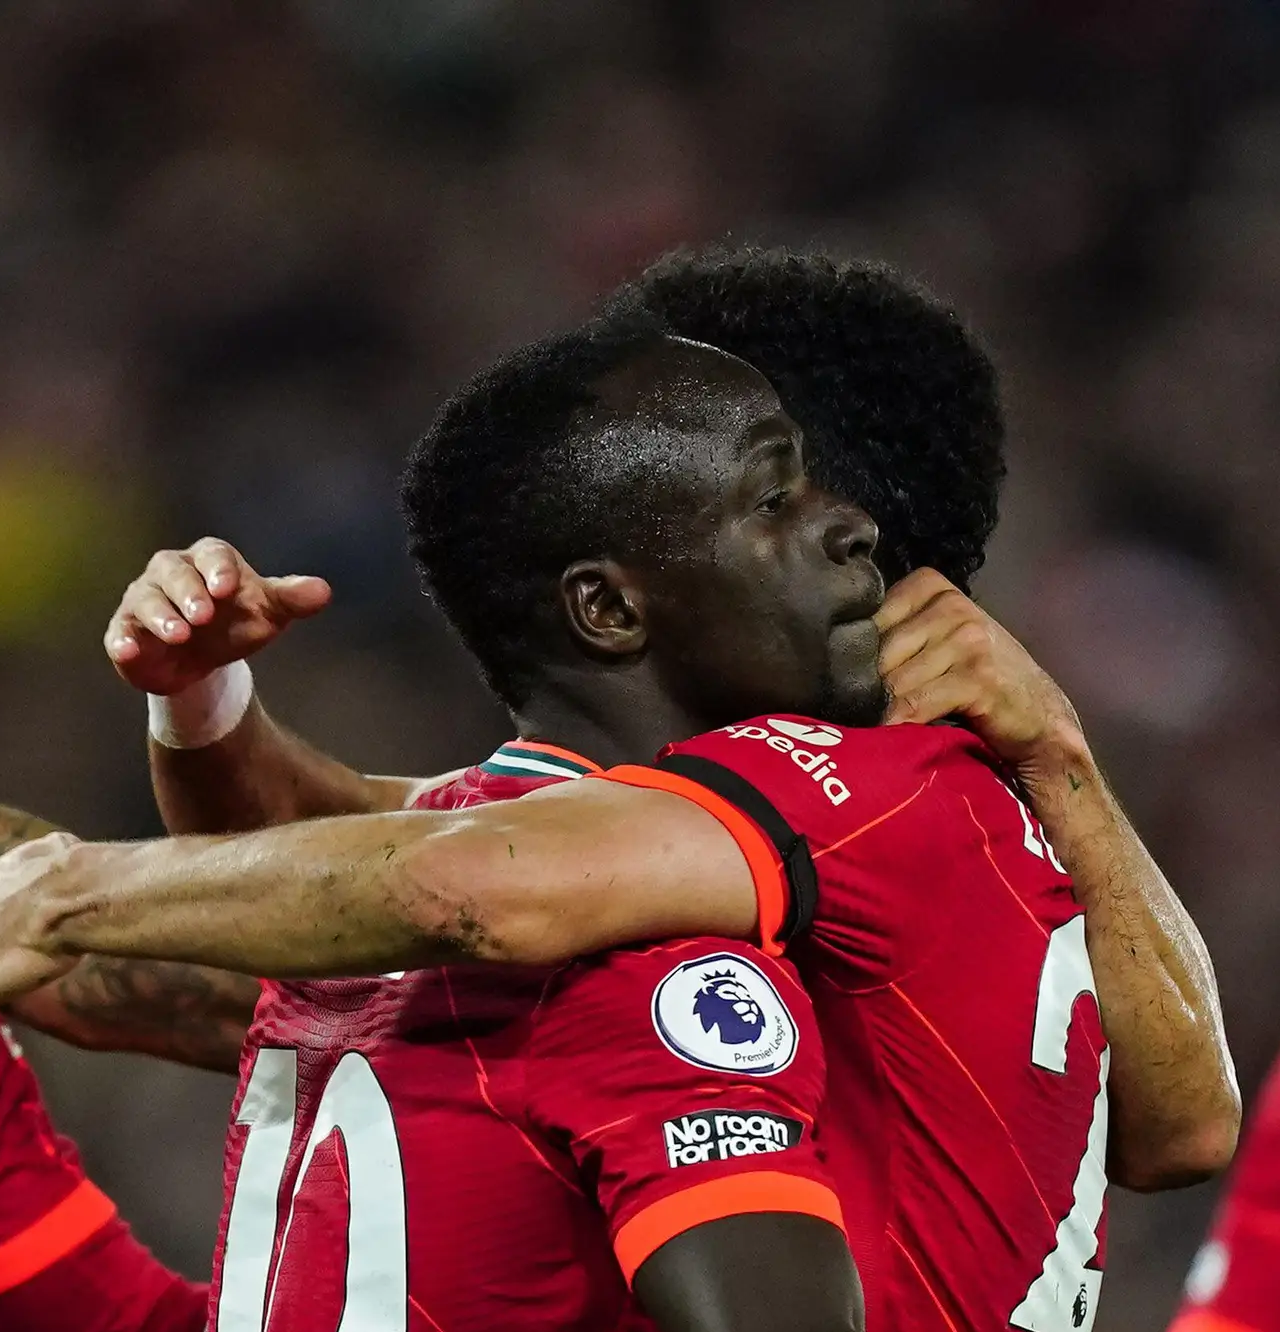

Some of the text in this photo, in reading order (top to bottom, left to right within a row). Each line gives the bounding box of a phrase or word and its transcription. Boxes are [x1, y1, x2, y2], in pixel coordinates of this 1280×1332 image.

[734, 1047, 774, 1063] Premier
[663, 1115, 789, 1150] No room
